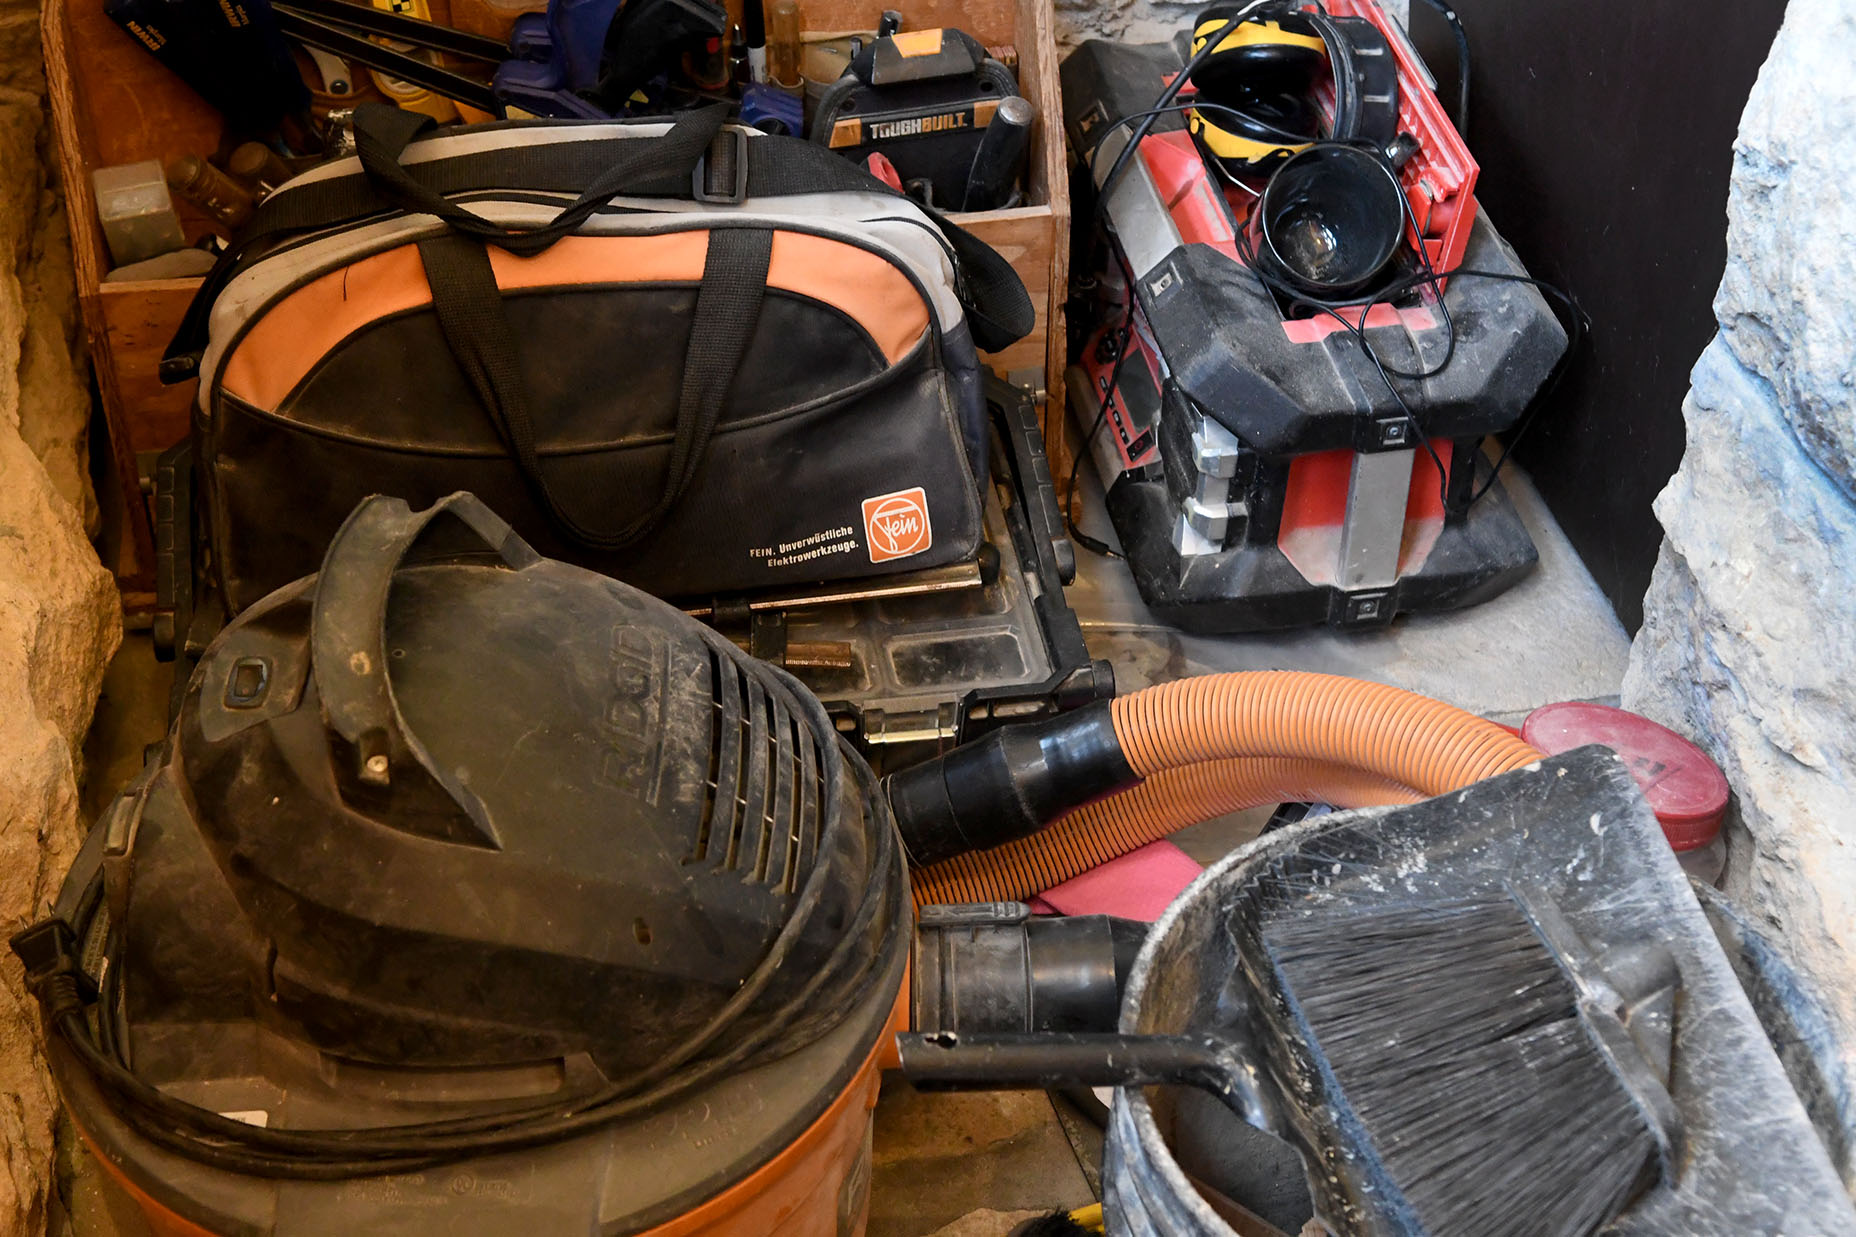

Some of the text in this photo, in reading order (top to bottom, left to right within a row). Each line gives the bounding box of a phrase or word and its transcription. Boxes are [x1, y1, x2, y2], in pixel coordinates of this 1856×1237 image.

[126, 20, 161, 51] IRWIN
[869, 112, 967, 140] TOUGHBUILT
[749, 525, 854, 559] FEIN. Unverwüstliche
[767, 539, 860, 568] Elektrowerkzeuge.
